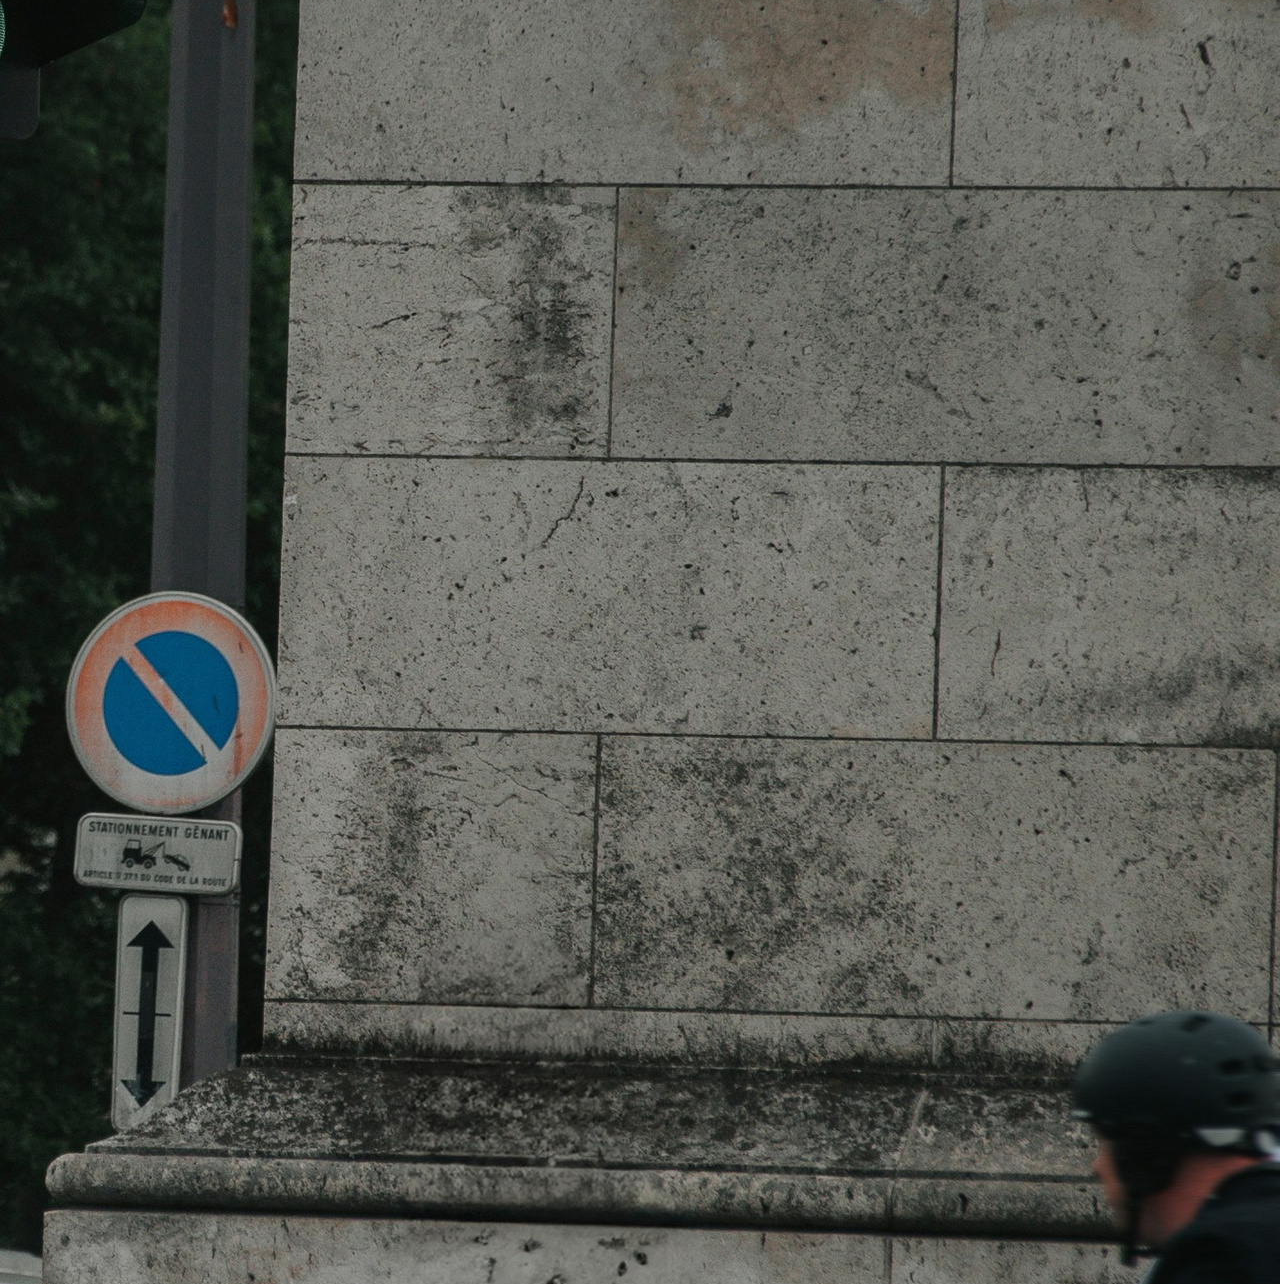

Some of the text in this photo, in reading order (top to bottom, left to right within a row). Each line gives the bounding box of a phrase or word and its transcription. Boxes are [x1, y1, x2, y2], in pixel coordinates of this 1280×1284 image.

[88, 821, 230, 842] STATIONNEMENT GÊNANT
[83, 869, 112, 879] ARTICLE
[154, 874, 173, 884] CODE
[177, 875, 186, 884] DE
[190, 876, 199, 884] LA
[203, 877, 226, 887] ROUTE
